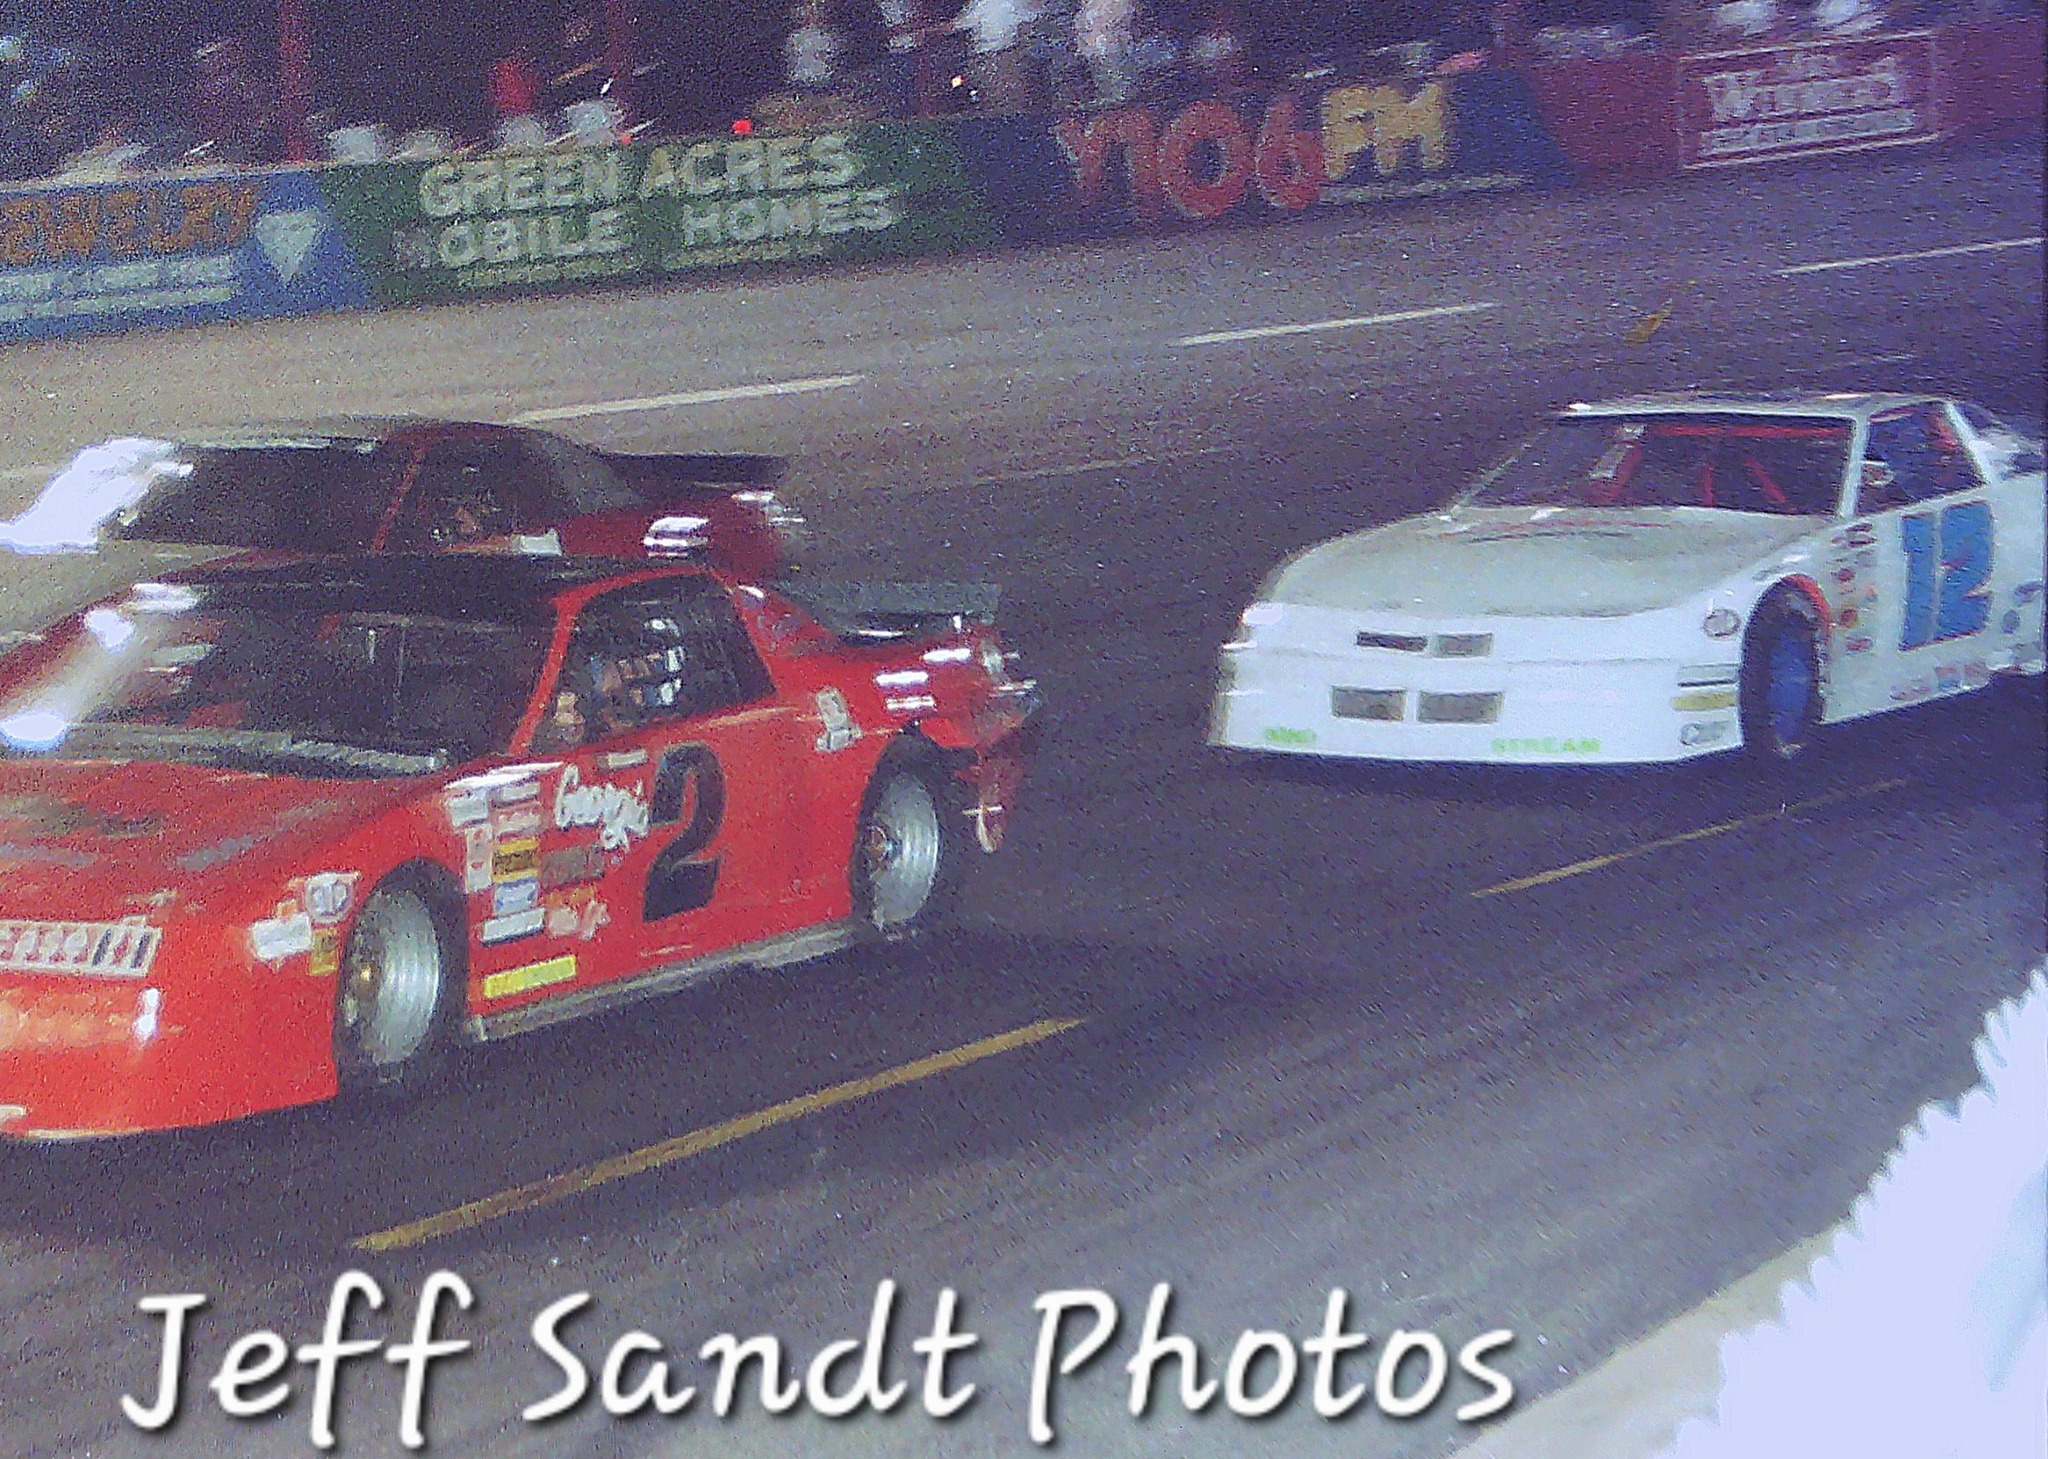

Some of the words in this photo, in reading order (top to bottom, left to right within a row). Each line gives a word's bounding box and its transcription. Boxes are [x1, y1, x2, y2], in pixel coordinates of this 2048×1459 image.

[419, 147, 621, 218] GREEN
[639, 131, 864, 200] ACRES
[1321, 82, 1447, 180] FM
[683, 188, 898, 247] HOMES
[642, 739, 727, 924] 2
